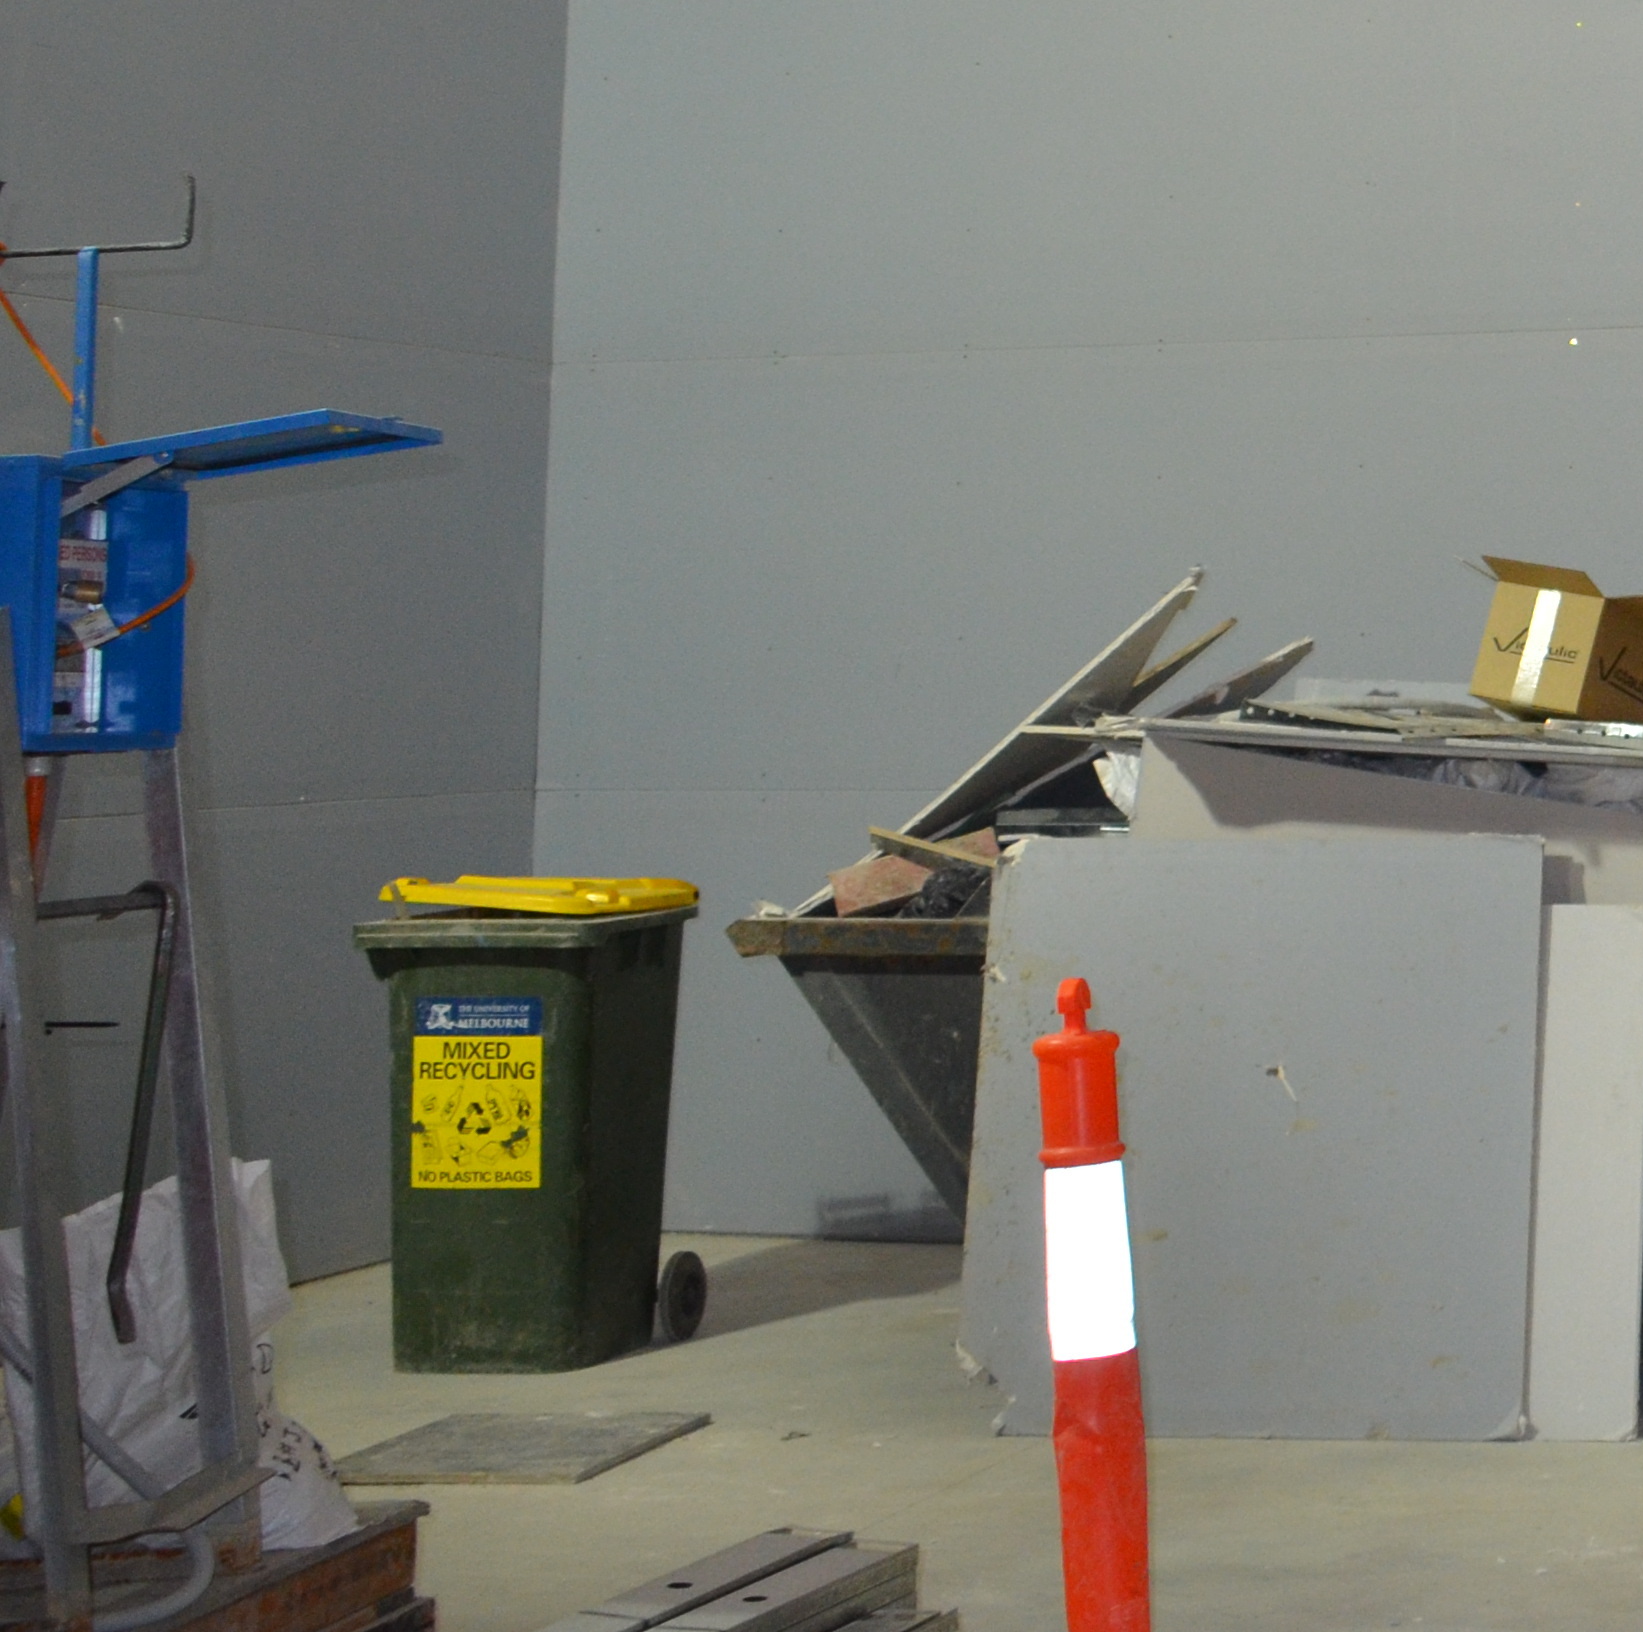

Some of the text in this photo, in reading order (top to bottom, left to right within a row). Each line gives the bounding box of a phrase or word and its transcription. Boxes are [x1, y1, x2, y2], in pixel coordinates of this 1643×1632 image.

[1493, 627, 1578, 660] Viculic
[458, 1018, 530, 1028] MELBOURNE
[443, 1042, 510, 1060] MIXED
[419, 1062, 535, 1080] RECYCLING
[418, 1171, 532, 1182] NO PLASTIC BAGS
